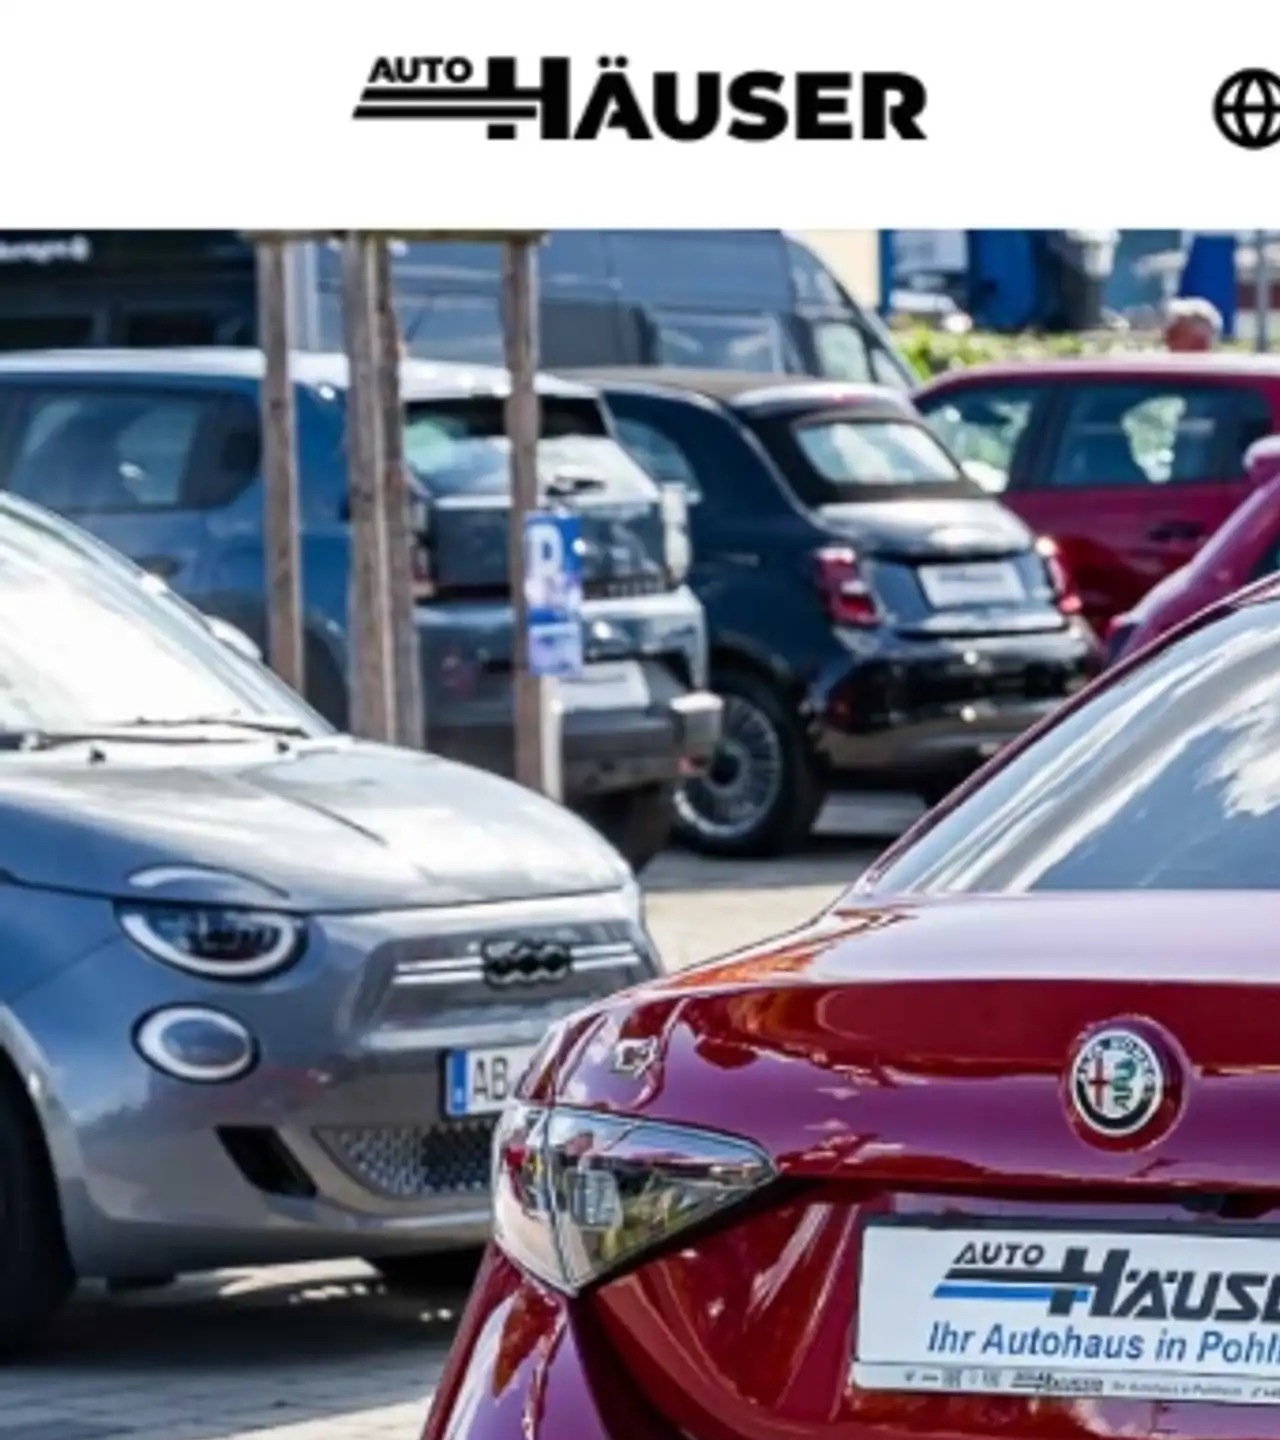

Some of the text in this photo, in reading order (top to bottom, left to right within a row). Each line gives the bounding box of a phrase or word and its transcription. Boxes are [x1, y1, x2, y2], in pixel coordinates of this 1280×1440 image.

[953, 1242, 1045, 1266] AUTO
[927, 1320, 976, 1354] Ihr
[980, 1322, 1145, 1361] Autohaus
[1154, 1328, 1188, 1363] in
